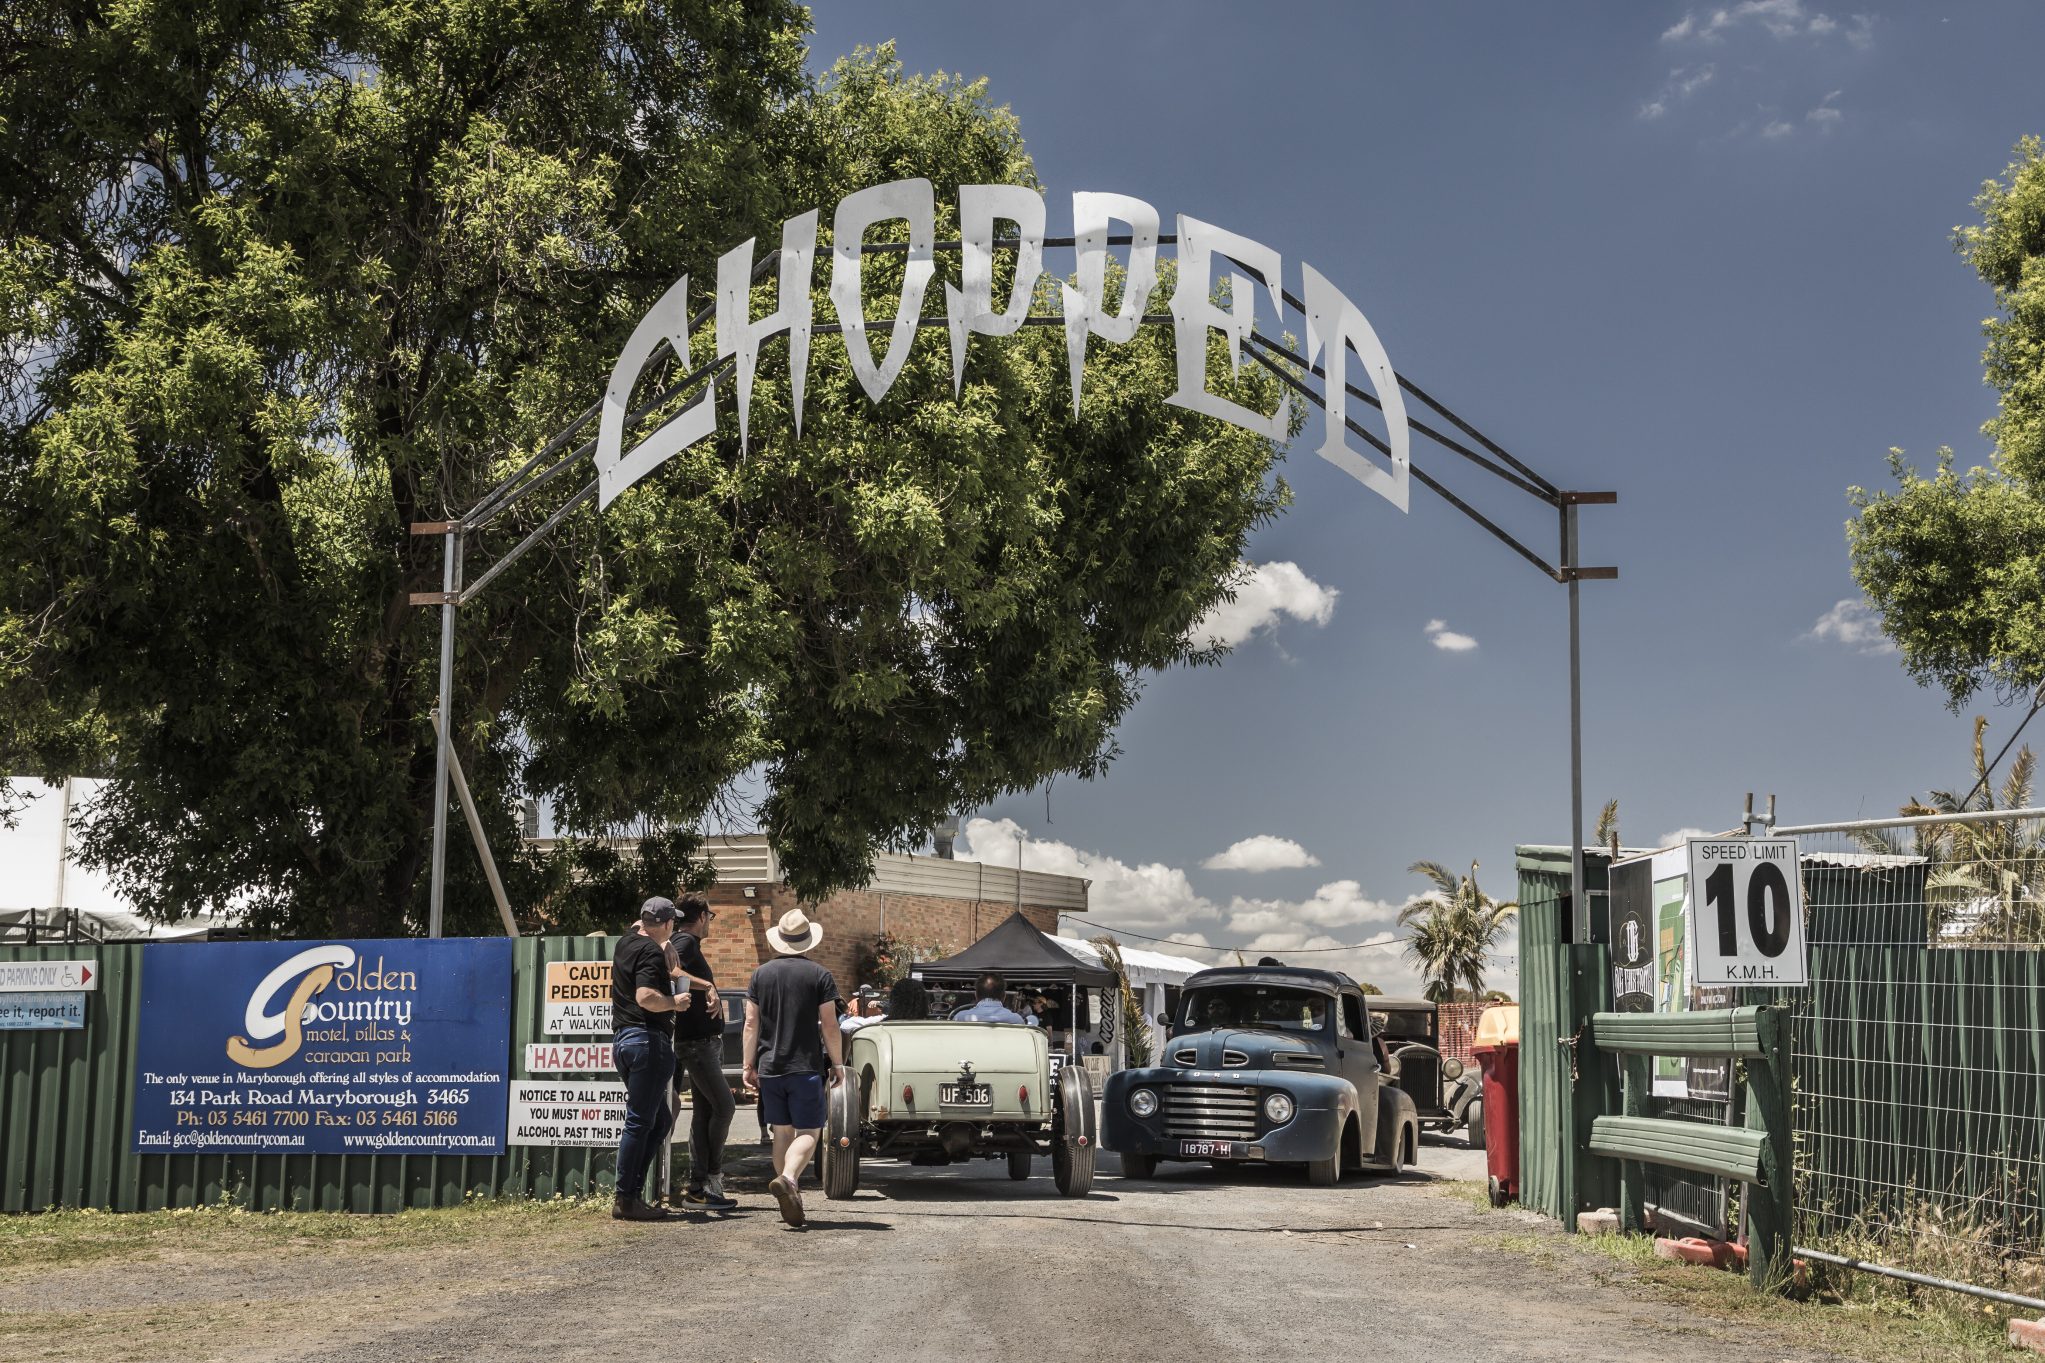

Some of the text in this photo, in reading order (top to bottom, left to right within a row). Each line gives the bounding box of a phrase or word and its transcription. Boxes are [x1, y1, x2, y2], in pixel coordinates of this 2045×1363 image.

[594, 177, 1410, 515] CHOPPED
[1702, 845, 1788, 860] SPEED LIMIT
[1705, 861, 1791, 959] 10
[6, 967, 38, 986] PARKING
[39, 966, 57, 986] ONLY
[1727, 965, 1779, 979] K.M.H.
[13, 1005, 25, 1019] it,
[28, 1005, 65, 1020] report
[69, 1004, 81, 1017] it.
[562, 1006, 584, 1017] ALL
[306, 1021, 411, 1043] motel, villas &
[549, 1019, 613, 1030] AT WALKIN
[304, 1044, 411, 1066] caravan park
[144, 1071, 501, 1086] The only venue in Maryborough offering all styles of accommodation
[1176, 1071, 1240, 1079] FORD
[170, 1088, 470, 1107] 134 Park Road Maryborough 3465
[520, 1089, 557, 1101] NOTICE
[560, 1090, 575, 1101] TO
[577, 1091, 597, 1102] ALL
[942, 1088, 989, 1104] UF 506
[176, 1110, 458, 1126] Ph: 03 5461 7700 Fax: 03 5461 5166
[530, 1108, 549, 1120] YOU
[552, 1109, 579, 1120] MUST
[581, 1109, 602, 1121] NOT
[138, 1129, 305, 1148] Email: gcc@goldencountry.com.au
[343, 1130, 496, 1149] www.goldencountry.com.au
[517, 1126, 561, 1138] ALCOHOL
[564, 1127, 589, 1138] PAST
[592, 1128, 613, 1139] THIS
[1185, 1143, 1229, 1155] 18787-H
